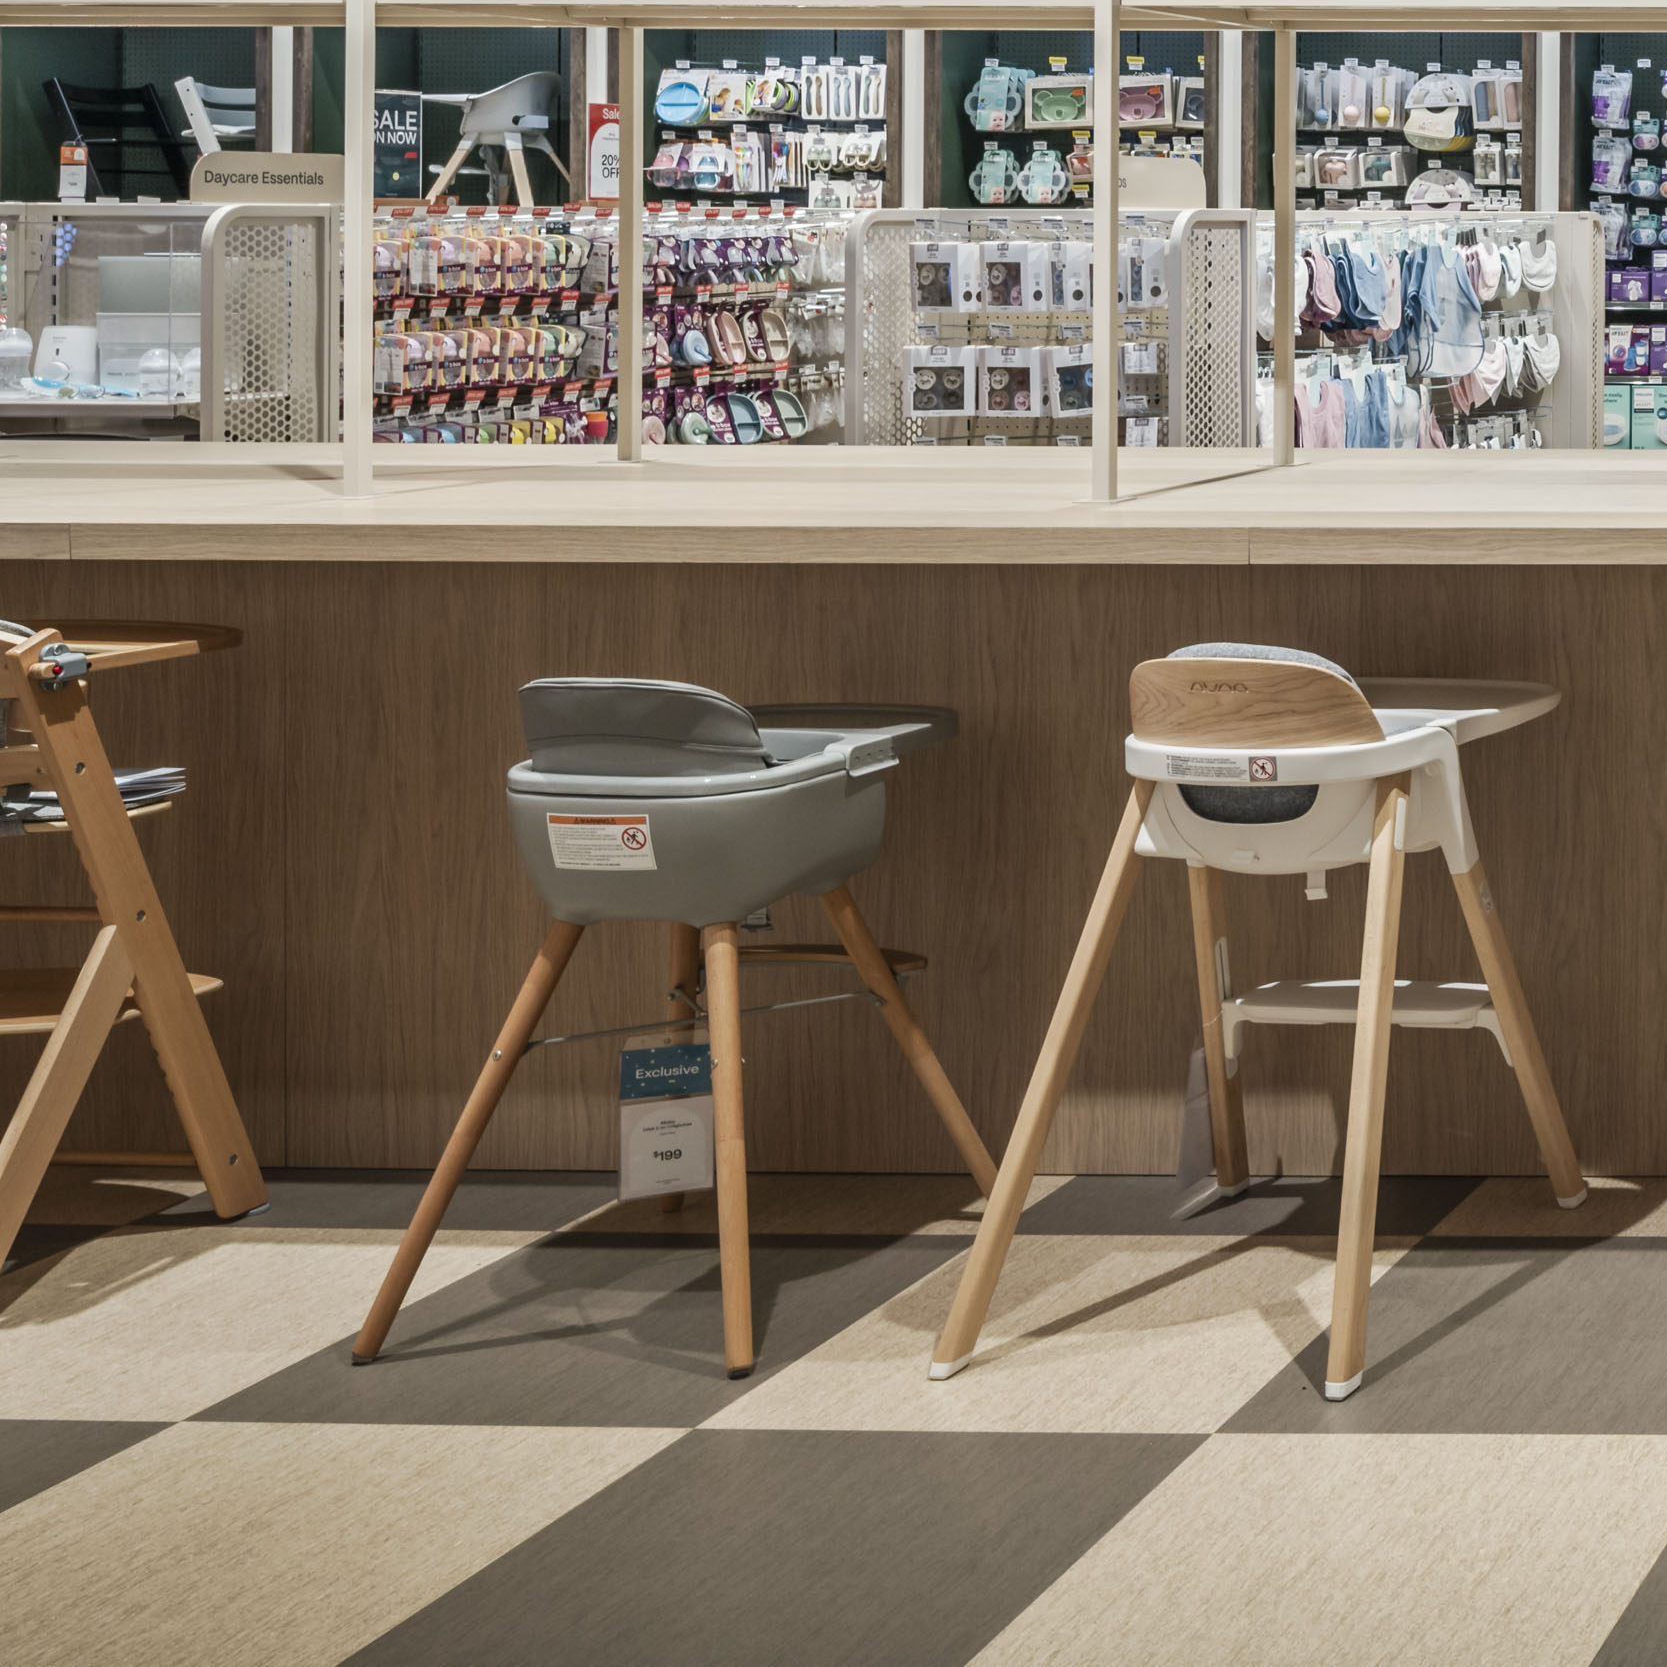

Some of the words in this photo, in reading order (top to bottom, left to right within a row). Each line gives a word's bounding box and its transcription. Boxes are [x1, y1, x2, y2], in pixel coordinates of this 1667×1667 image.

[388, 132, 417, 144] NOW
[204, 170, 258, 186] Daycare
[262, 171, 324, 185] Essentials
[636, 1065, 699, 1079] Exclusive
[653, 1149, 682, 1161] $199
